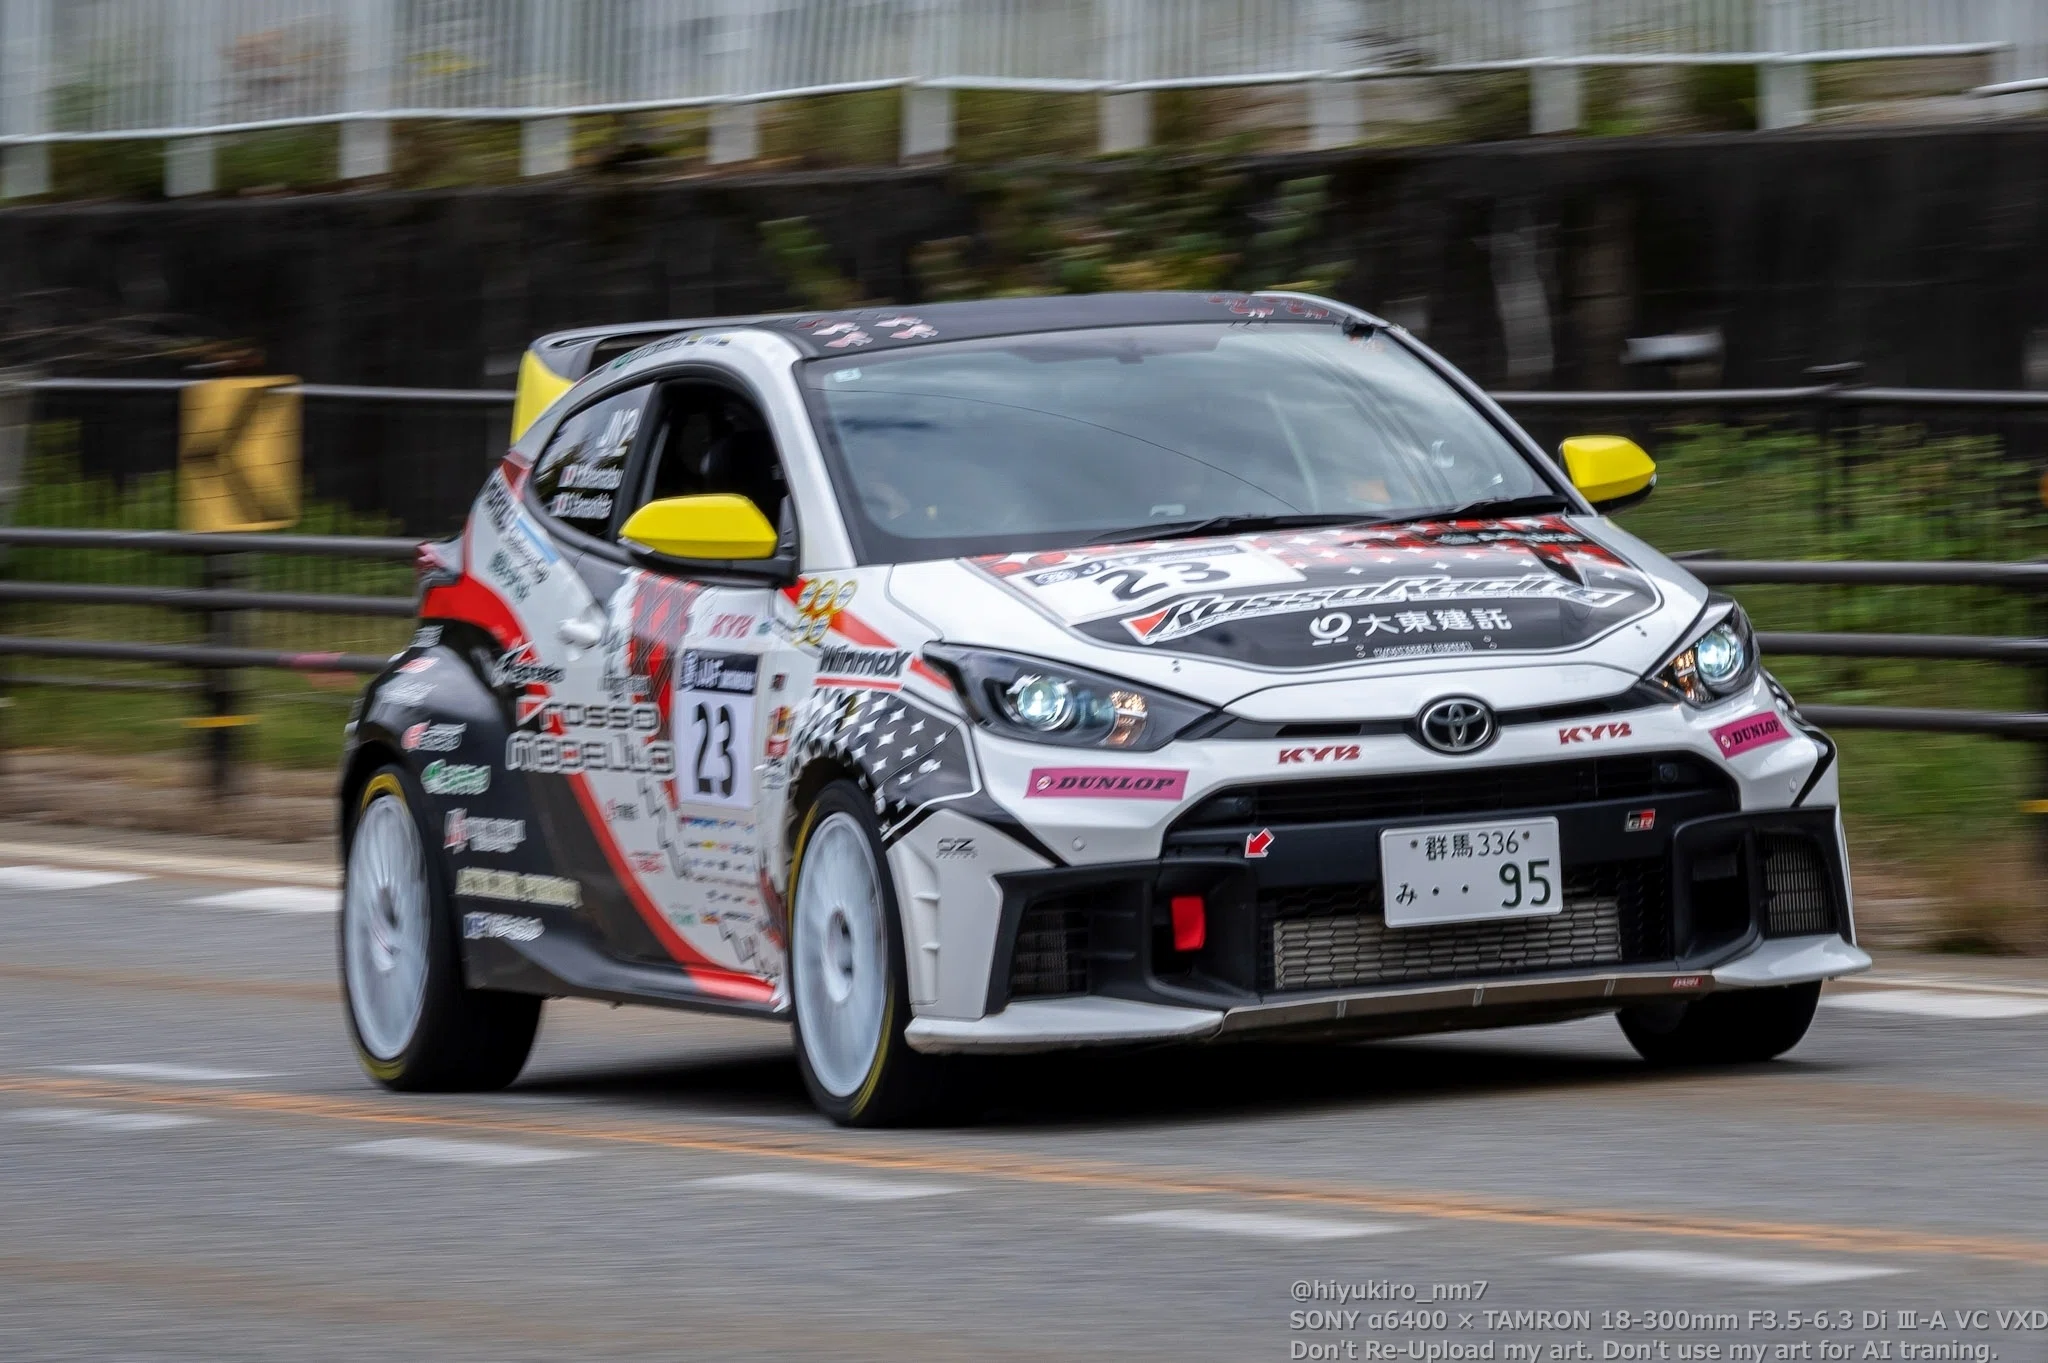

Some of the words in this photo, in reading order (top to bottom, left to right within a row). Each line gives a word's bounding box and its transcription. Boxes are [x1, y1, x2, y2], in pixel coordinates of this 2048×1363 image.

[1095, 561, 1231, 601] 23
[1357, 607, 1513, 636] 大東建託
[1559, 722, 1633, 745] KYB
[1732, 718, 1781, 745] DUNLOP
[692, 702, 734, 797] 23
[1278, 744, 1361, 764] KYB
[1055, 776, 1175, 792] DUNLOP
